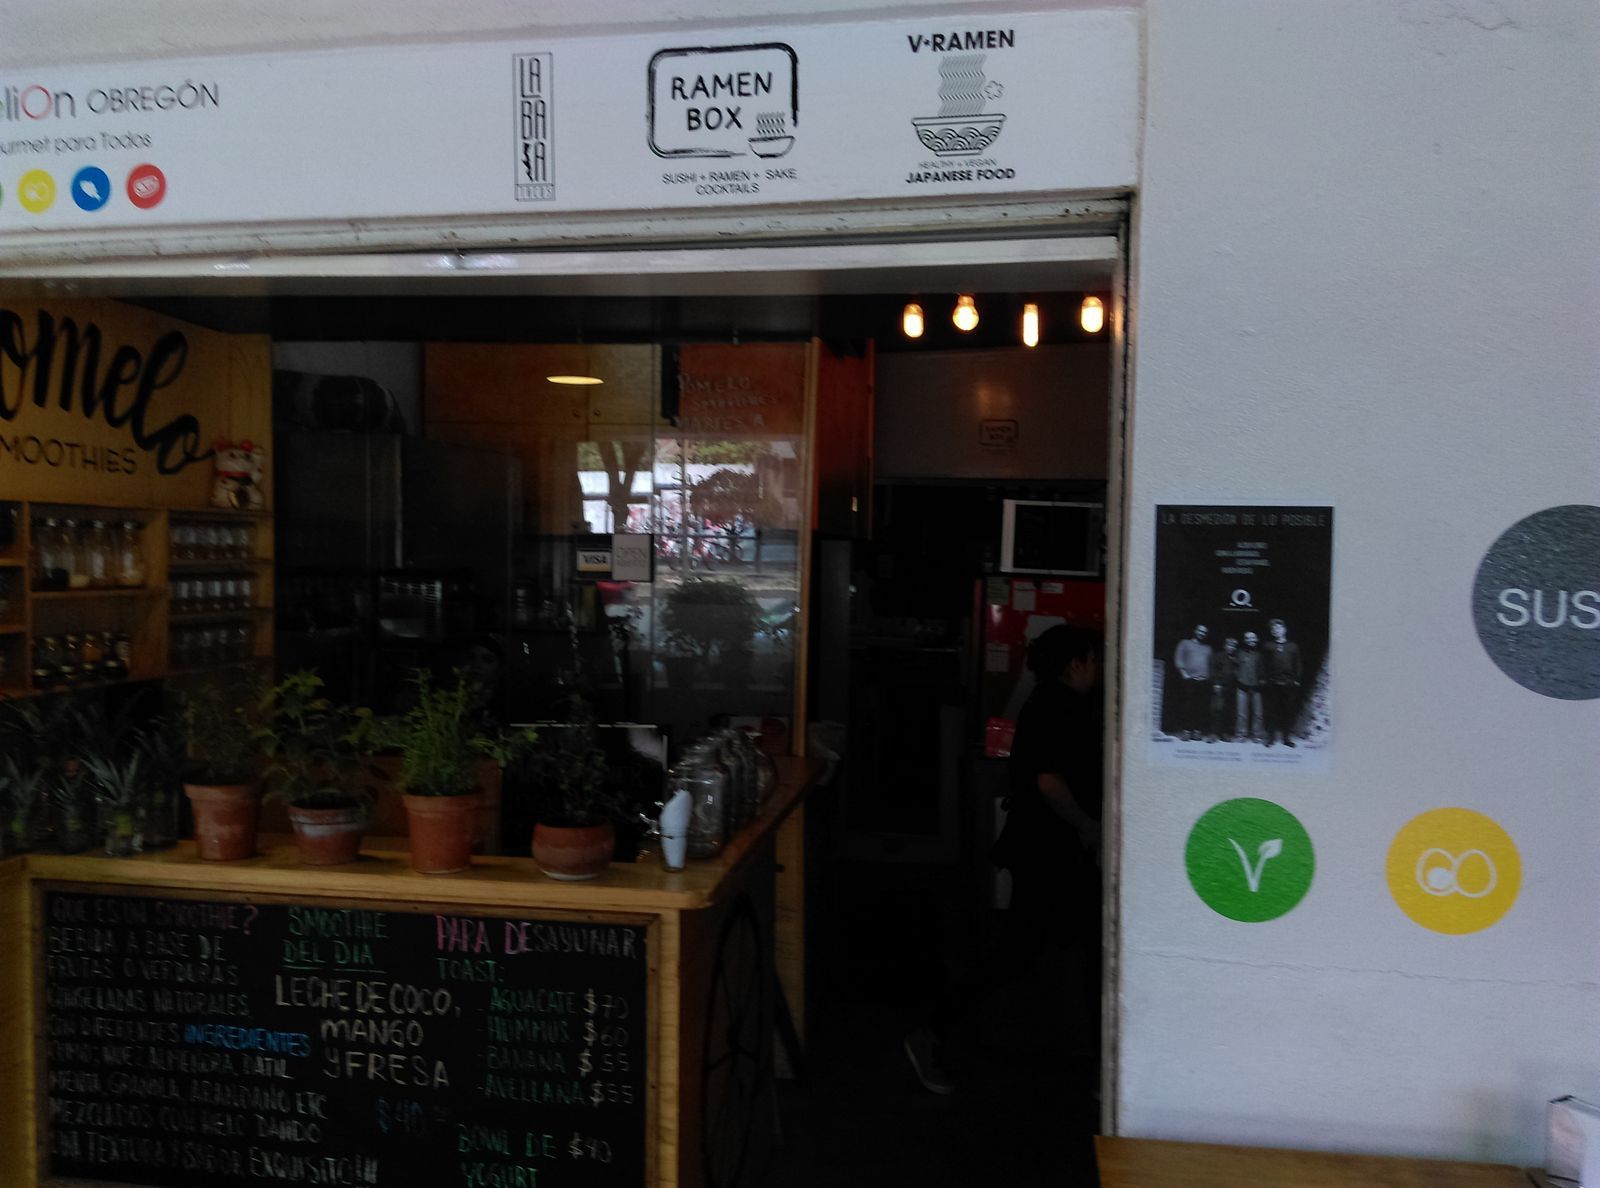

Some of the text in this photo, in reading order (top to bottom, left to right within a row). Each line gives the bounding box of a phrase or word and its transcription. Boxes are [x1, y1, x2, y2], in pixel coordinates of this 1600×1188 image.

[86, 79, 220, 116] OBREGÓN
[672, 71, 772, 100] RAMEN
[687, 106, 743, 131] BOX
[55, 136, 97, 156] para
[662, 172, 698, 185] SUSHI
[709, 169, 751, 183] RAMEN
[765, 168, 798, 181] SAKE
[695, 182, 760, 196] COCKTAILS
[906, 168, 1016, 184] JAPANESE FOOD
[582, 553, 607, 565] VISA
[1229, 588, 1254, 608] Q
[1496, 588, 1600, 630] SUS
[288, 906, 389, 940] SMOOTHIE
[435, 914, 639, 960] PARA DESAYUNAR
[198, 932, 226, 962] DE
[281, 938, 376, 967] DEL DIA
[275, 974, 353, 1013] LECHE
[354, 981, 389, 1015] DE
[319, 1018, 425, 1049] MANGO
[345, 1050, 450, 1089] FRESA
[524, 1129, 561, 1161] DE
